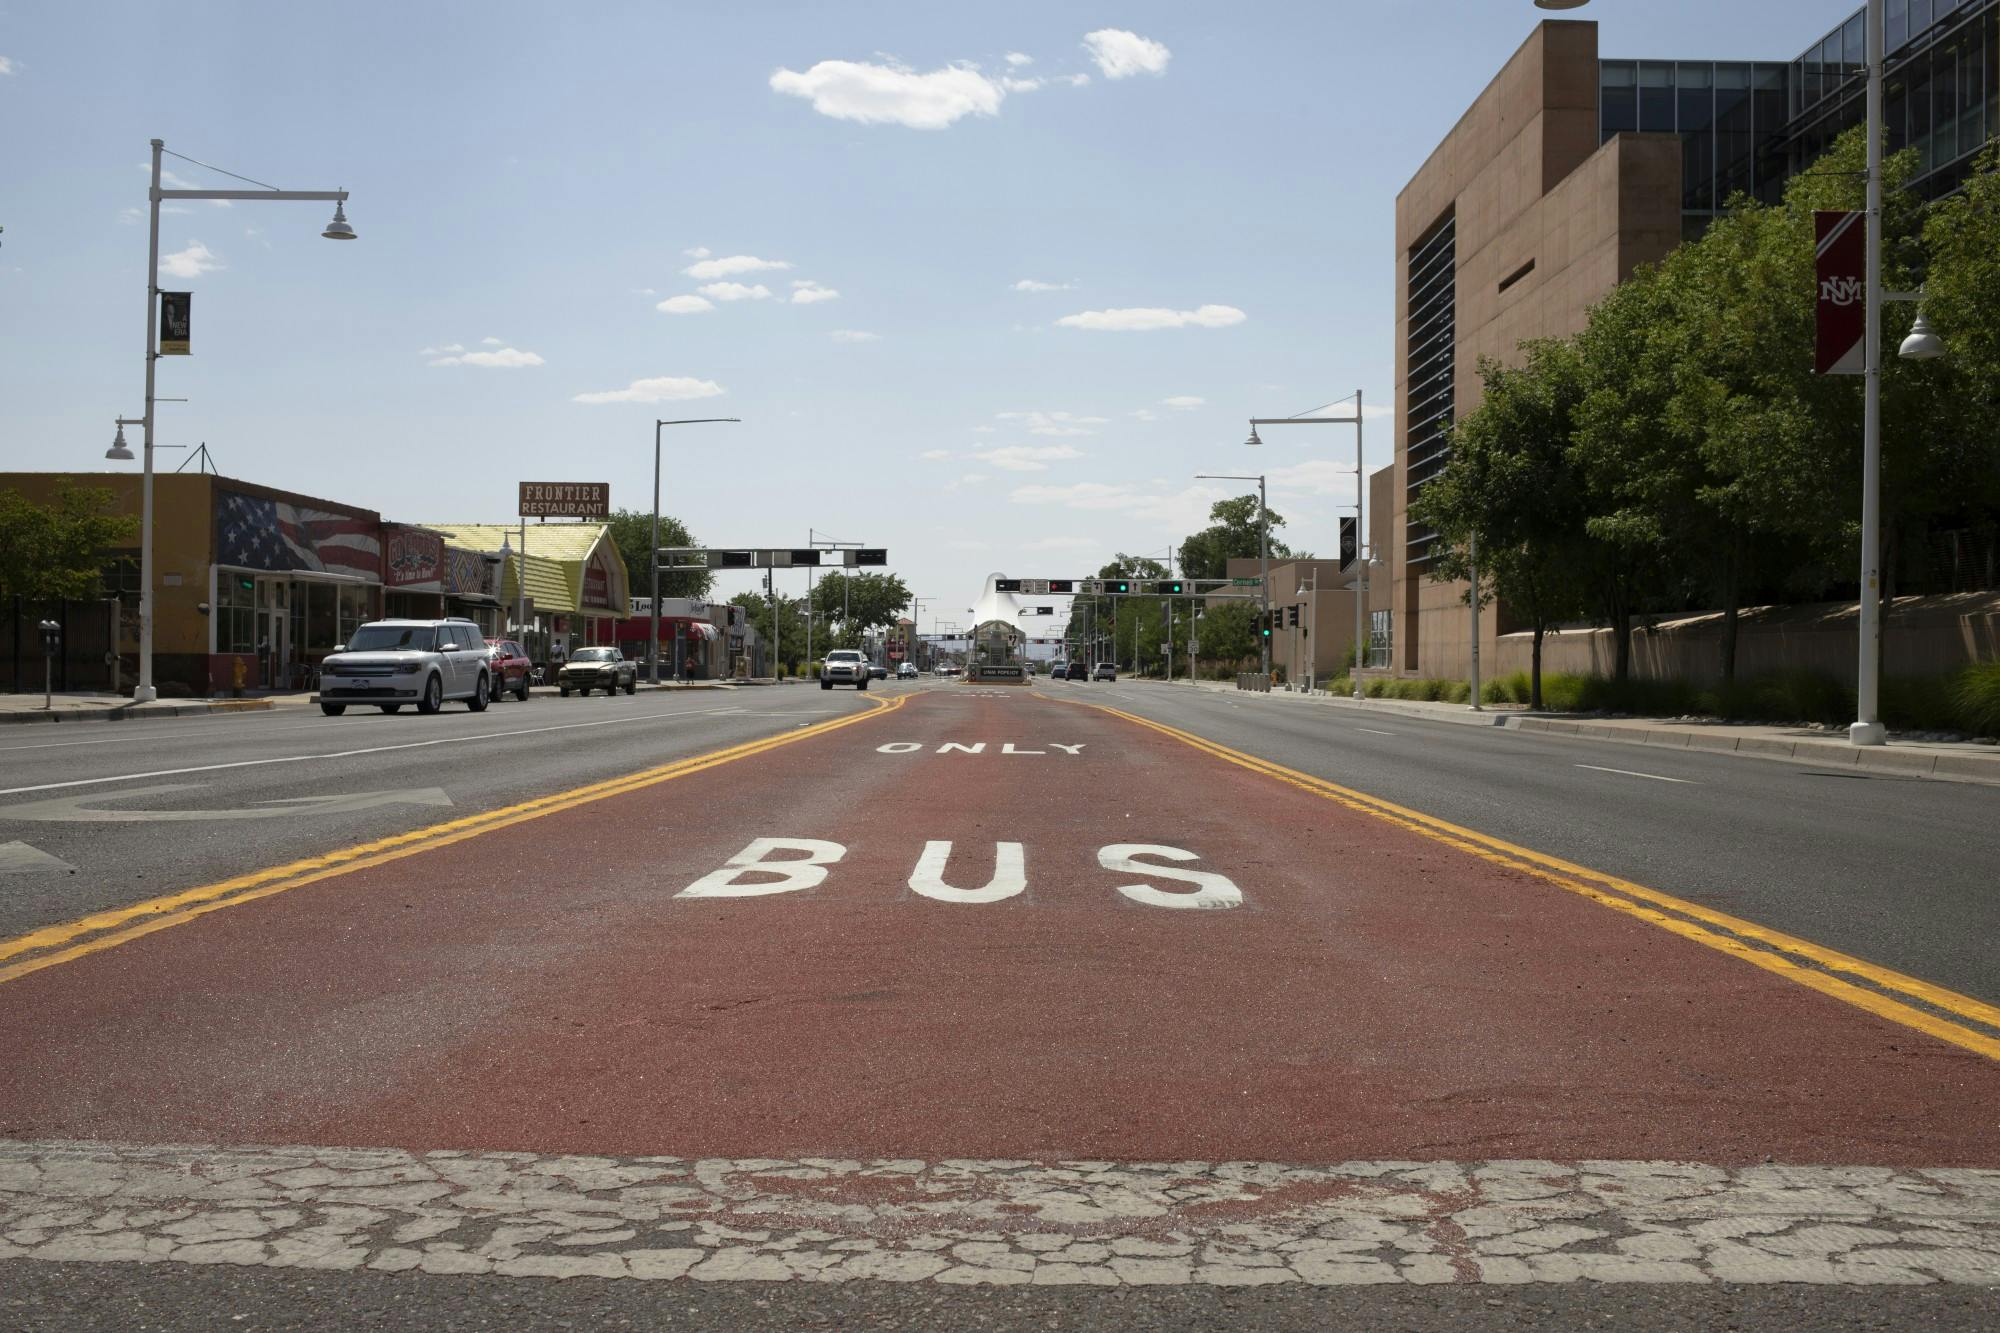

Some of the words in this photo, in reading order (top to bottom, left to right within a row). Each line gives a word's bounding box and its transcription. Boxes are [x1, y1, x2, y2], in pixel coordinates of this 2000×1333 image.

[525, 485, 601, 501] FRONTIER
[522, 502, 603, 514] RESTAURANT
[875, 741, 1087, 755] ONLY
[672, 836, 1244, 909] BUS
